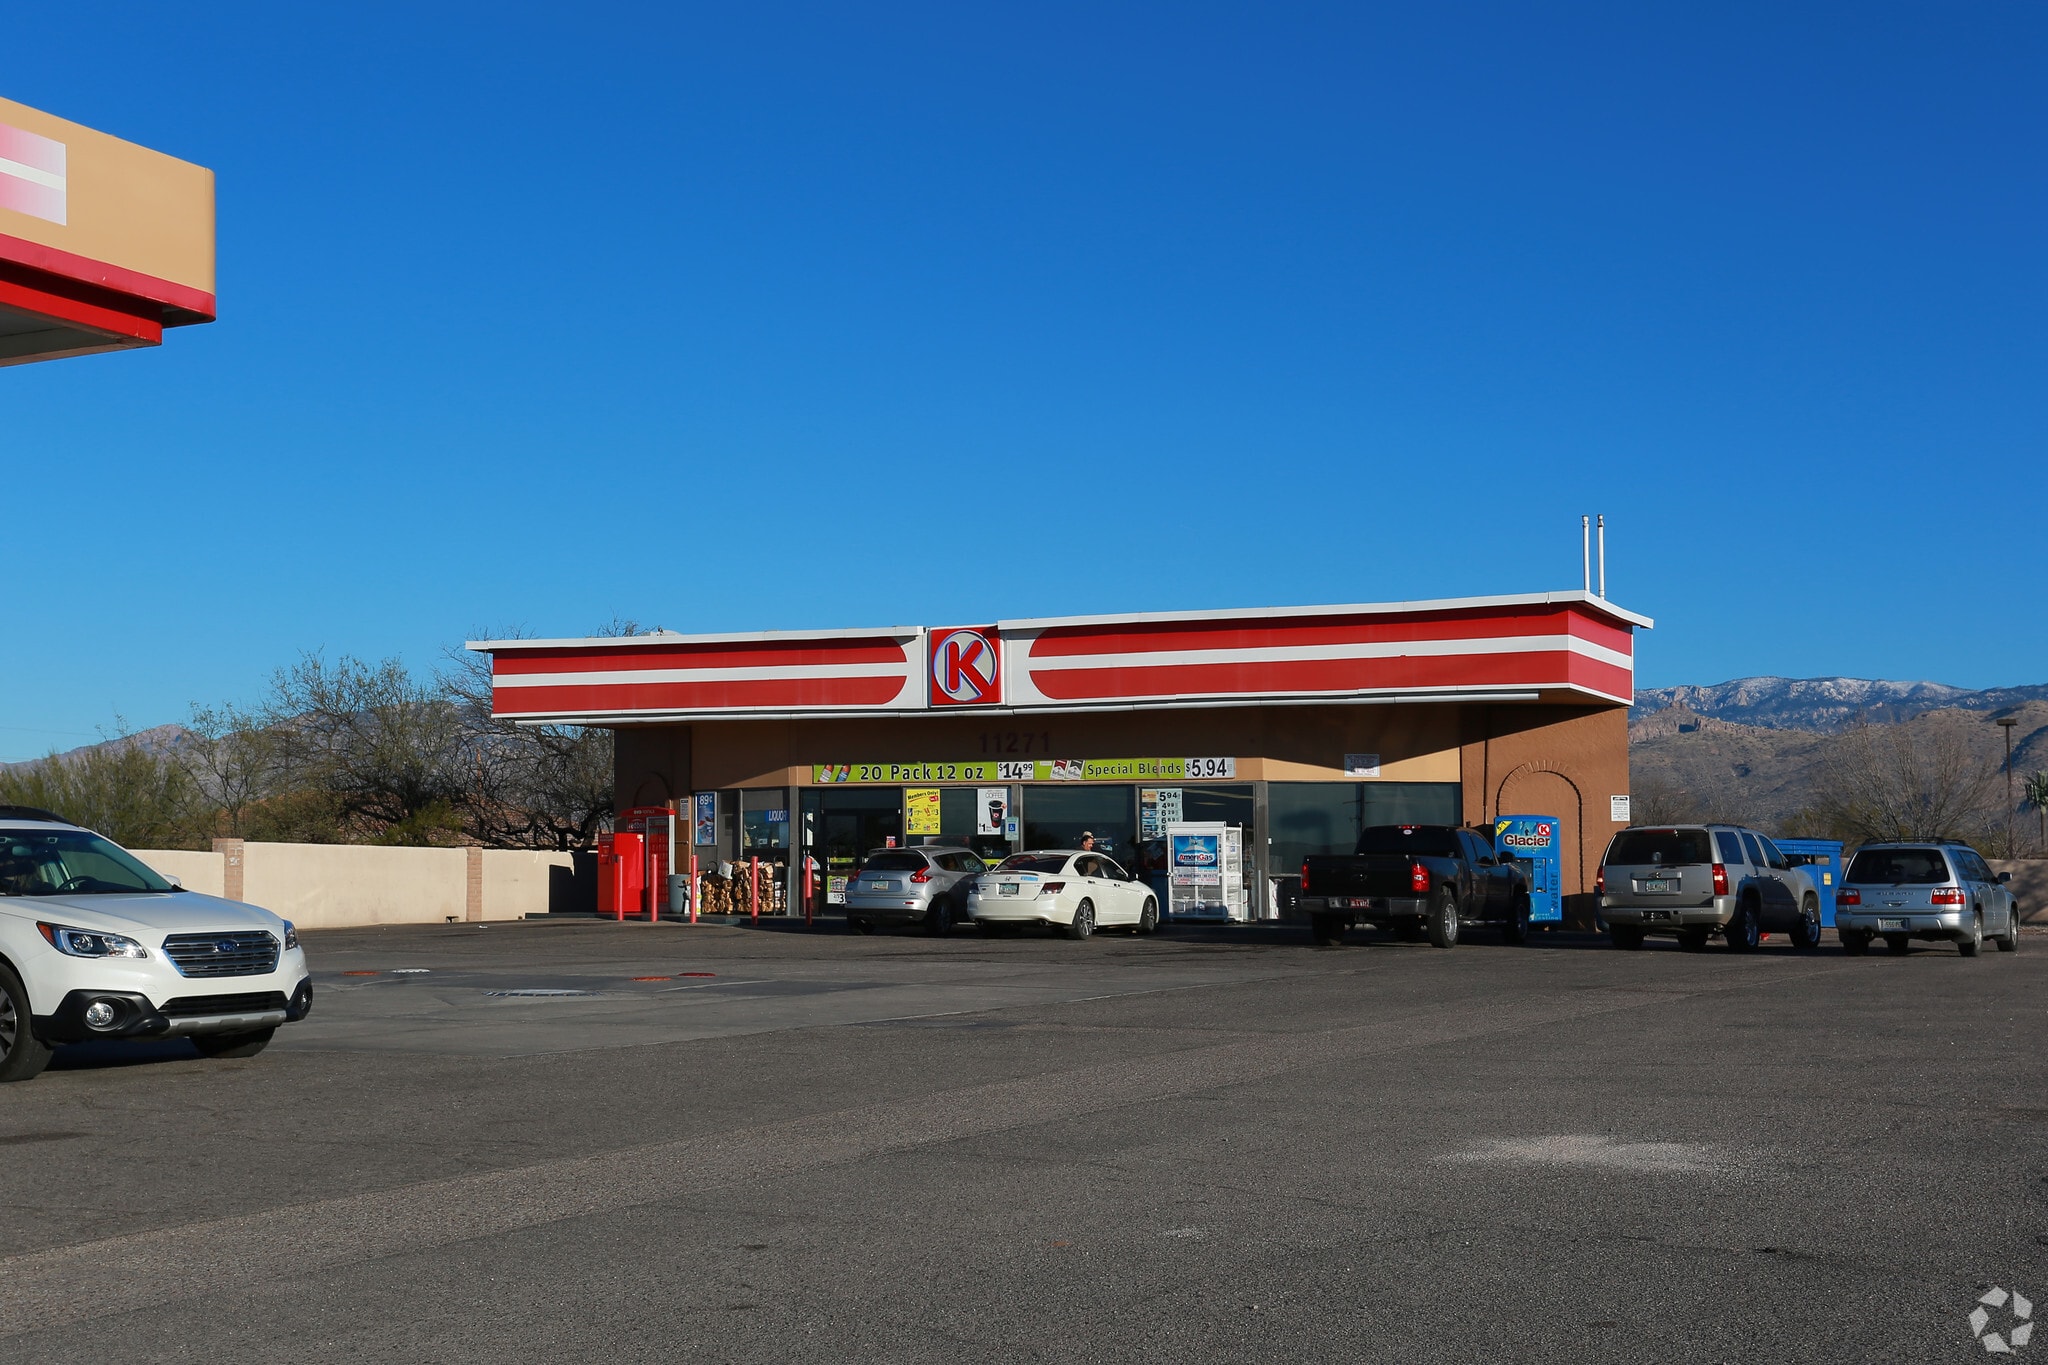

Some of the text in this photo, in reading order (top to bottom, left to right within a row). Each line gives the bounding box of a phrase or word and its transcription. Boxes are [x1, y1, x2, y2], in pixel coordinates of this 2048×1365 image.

[978, 731, 1049, 753] 11271
[860, 763, 983, 780] 20 Pack 12 oz
[1087, 763, 1133, 777] Special
[1138, 762, 1181, 774] Blends
[1185, 758, 1227, 777] $5.94
[1504, 834, 1551, 846] Glacier
[1178, 853, 1214, 862] AmeriGas
[1549, 872, 1559, 909] water
